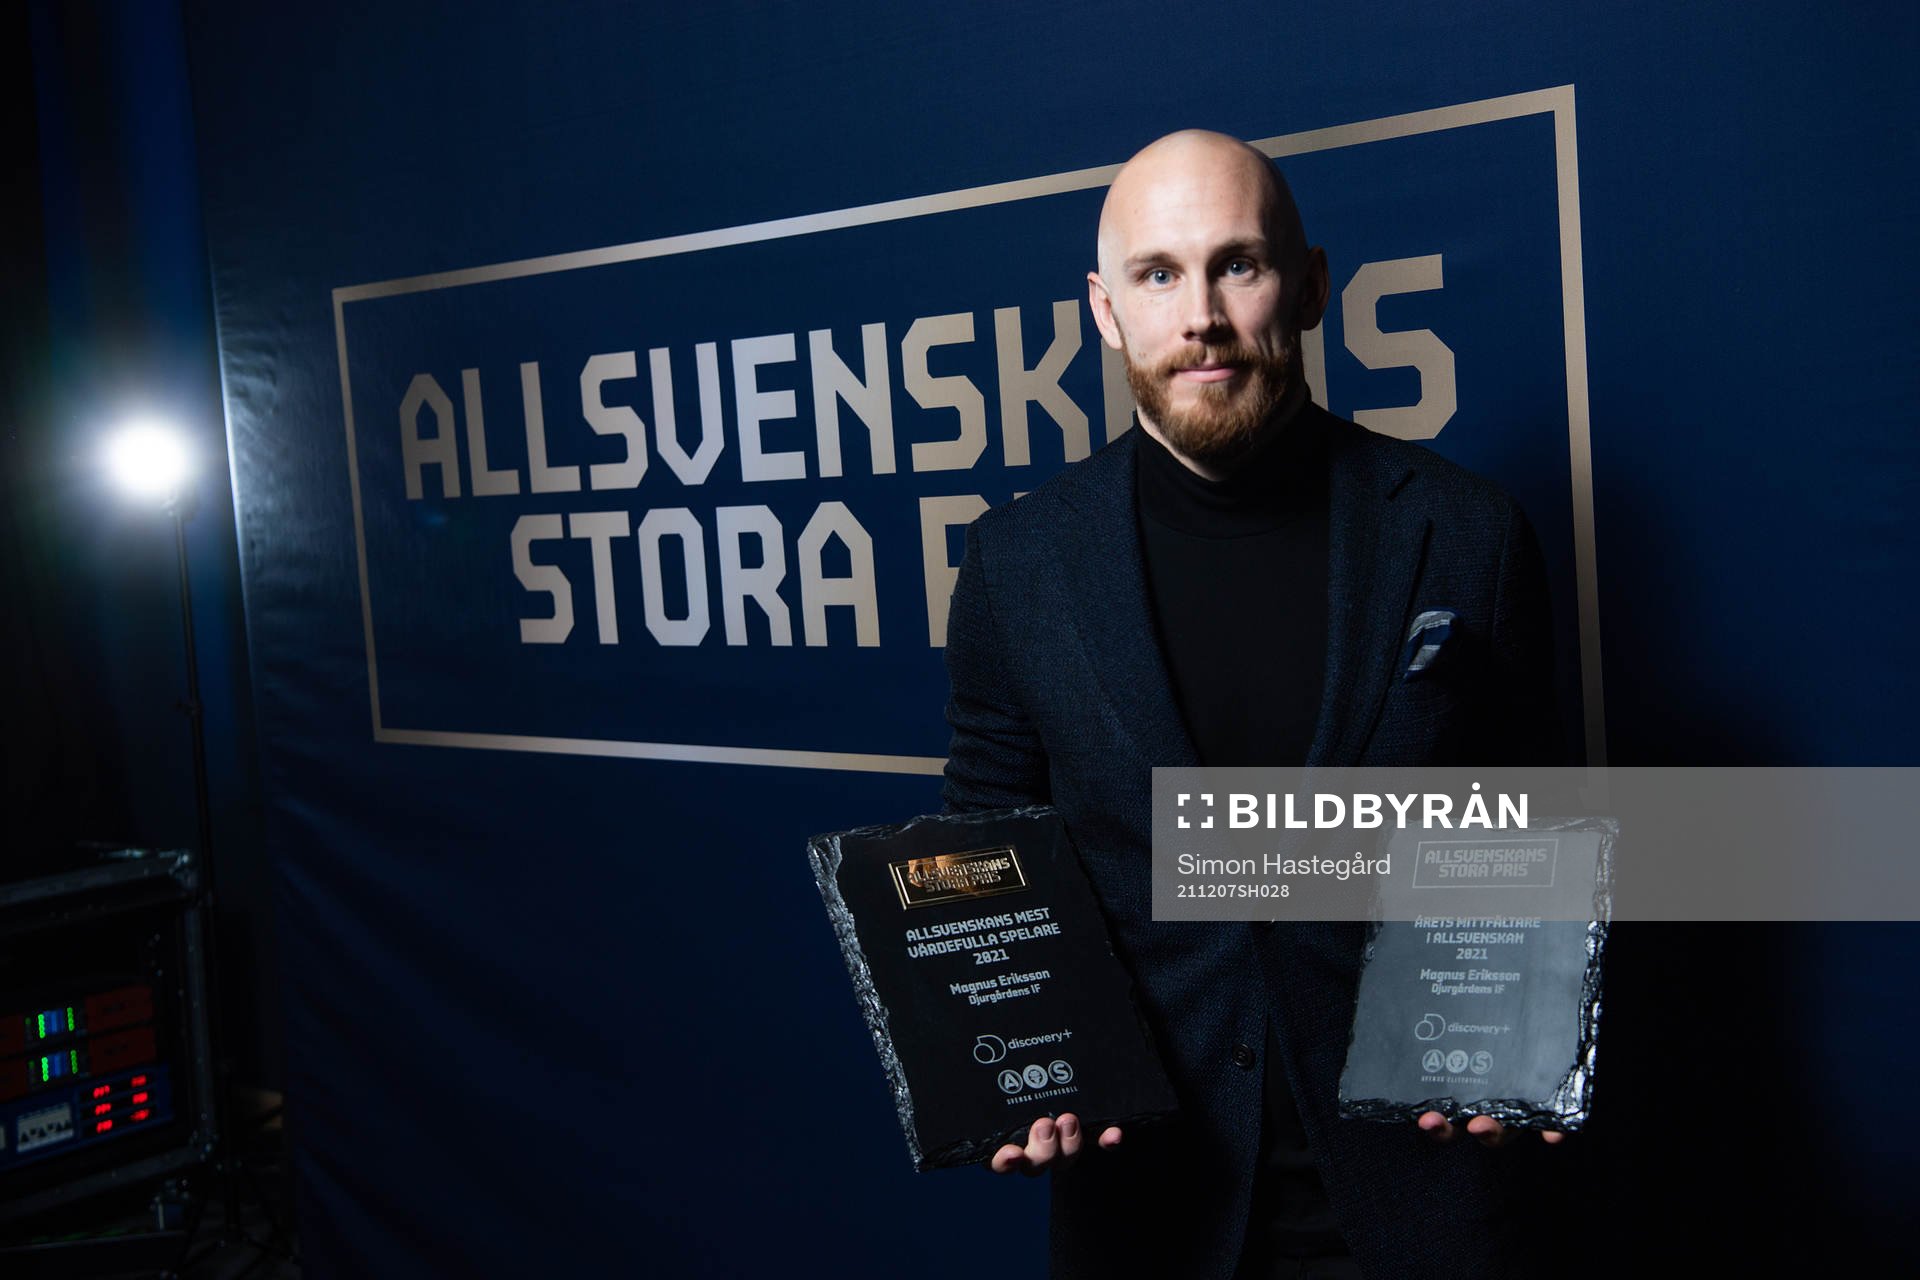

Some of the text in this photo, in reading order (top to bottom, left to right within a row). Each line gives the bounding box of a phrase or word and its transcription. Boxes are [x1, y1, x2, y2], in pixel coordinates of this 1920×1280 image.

[400, 254, 1457, 500] ALLSVENSKS
[510, 501, 881, 647] STORA
[1424, 848, 1548, 864] ALLSVENSKANS
[1438, 862, 1529, 878] STORA PRIS
[906, 907, 1051, 942] ALLSVENSKANS MEST
[907, 922, 1061, 959] VÄRDEFULLA SPELARE
[1432, 932, 1525, 945] ALLSVENSKAN
[972, 949, 1010, 965] 2021
[1455, 948, 1489, 960] 2021
[949, 970, 1050, 996] Magnus Eriksson
[1420, 968, 1521, 983] Magnus Eriksson
[968, 983, 1041, 1006] Djurgårdens IF
[1431, 983, 1493, 996] Djurgårdens
[1447, 1022, 1512, 1036] discovery+
[1007, 1028, 1073, 1050] discovery+
